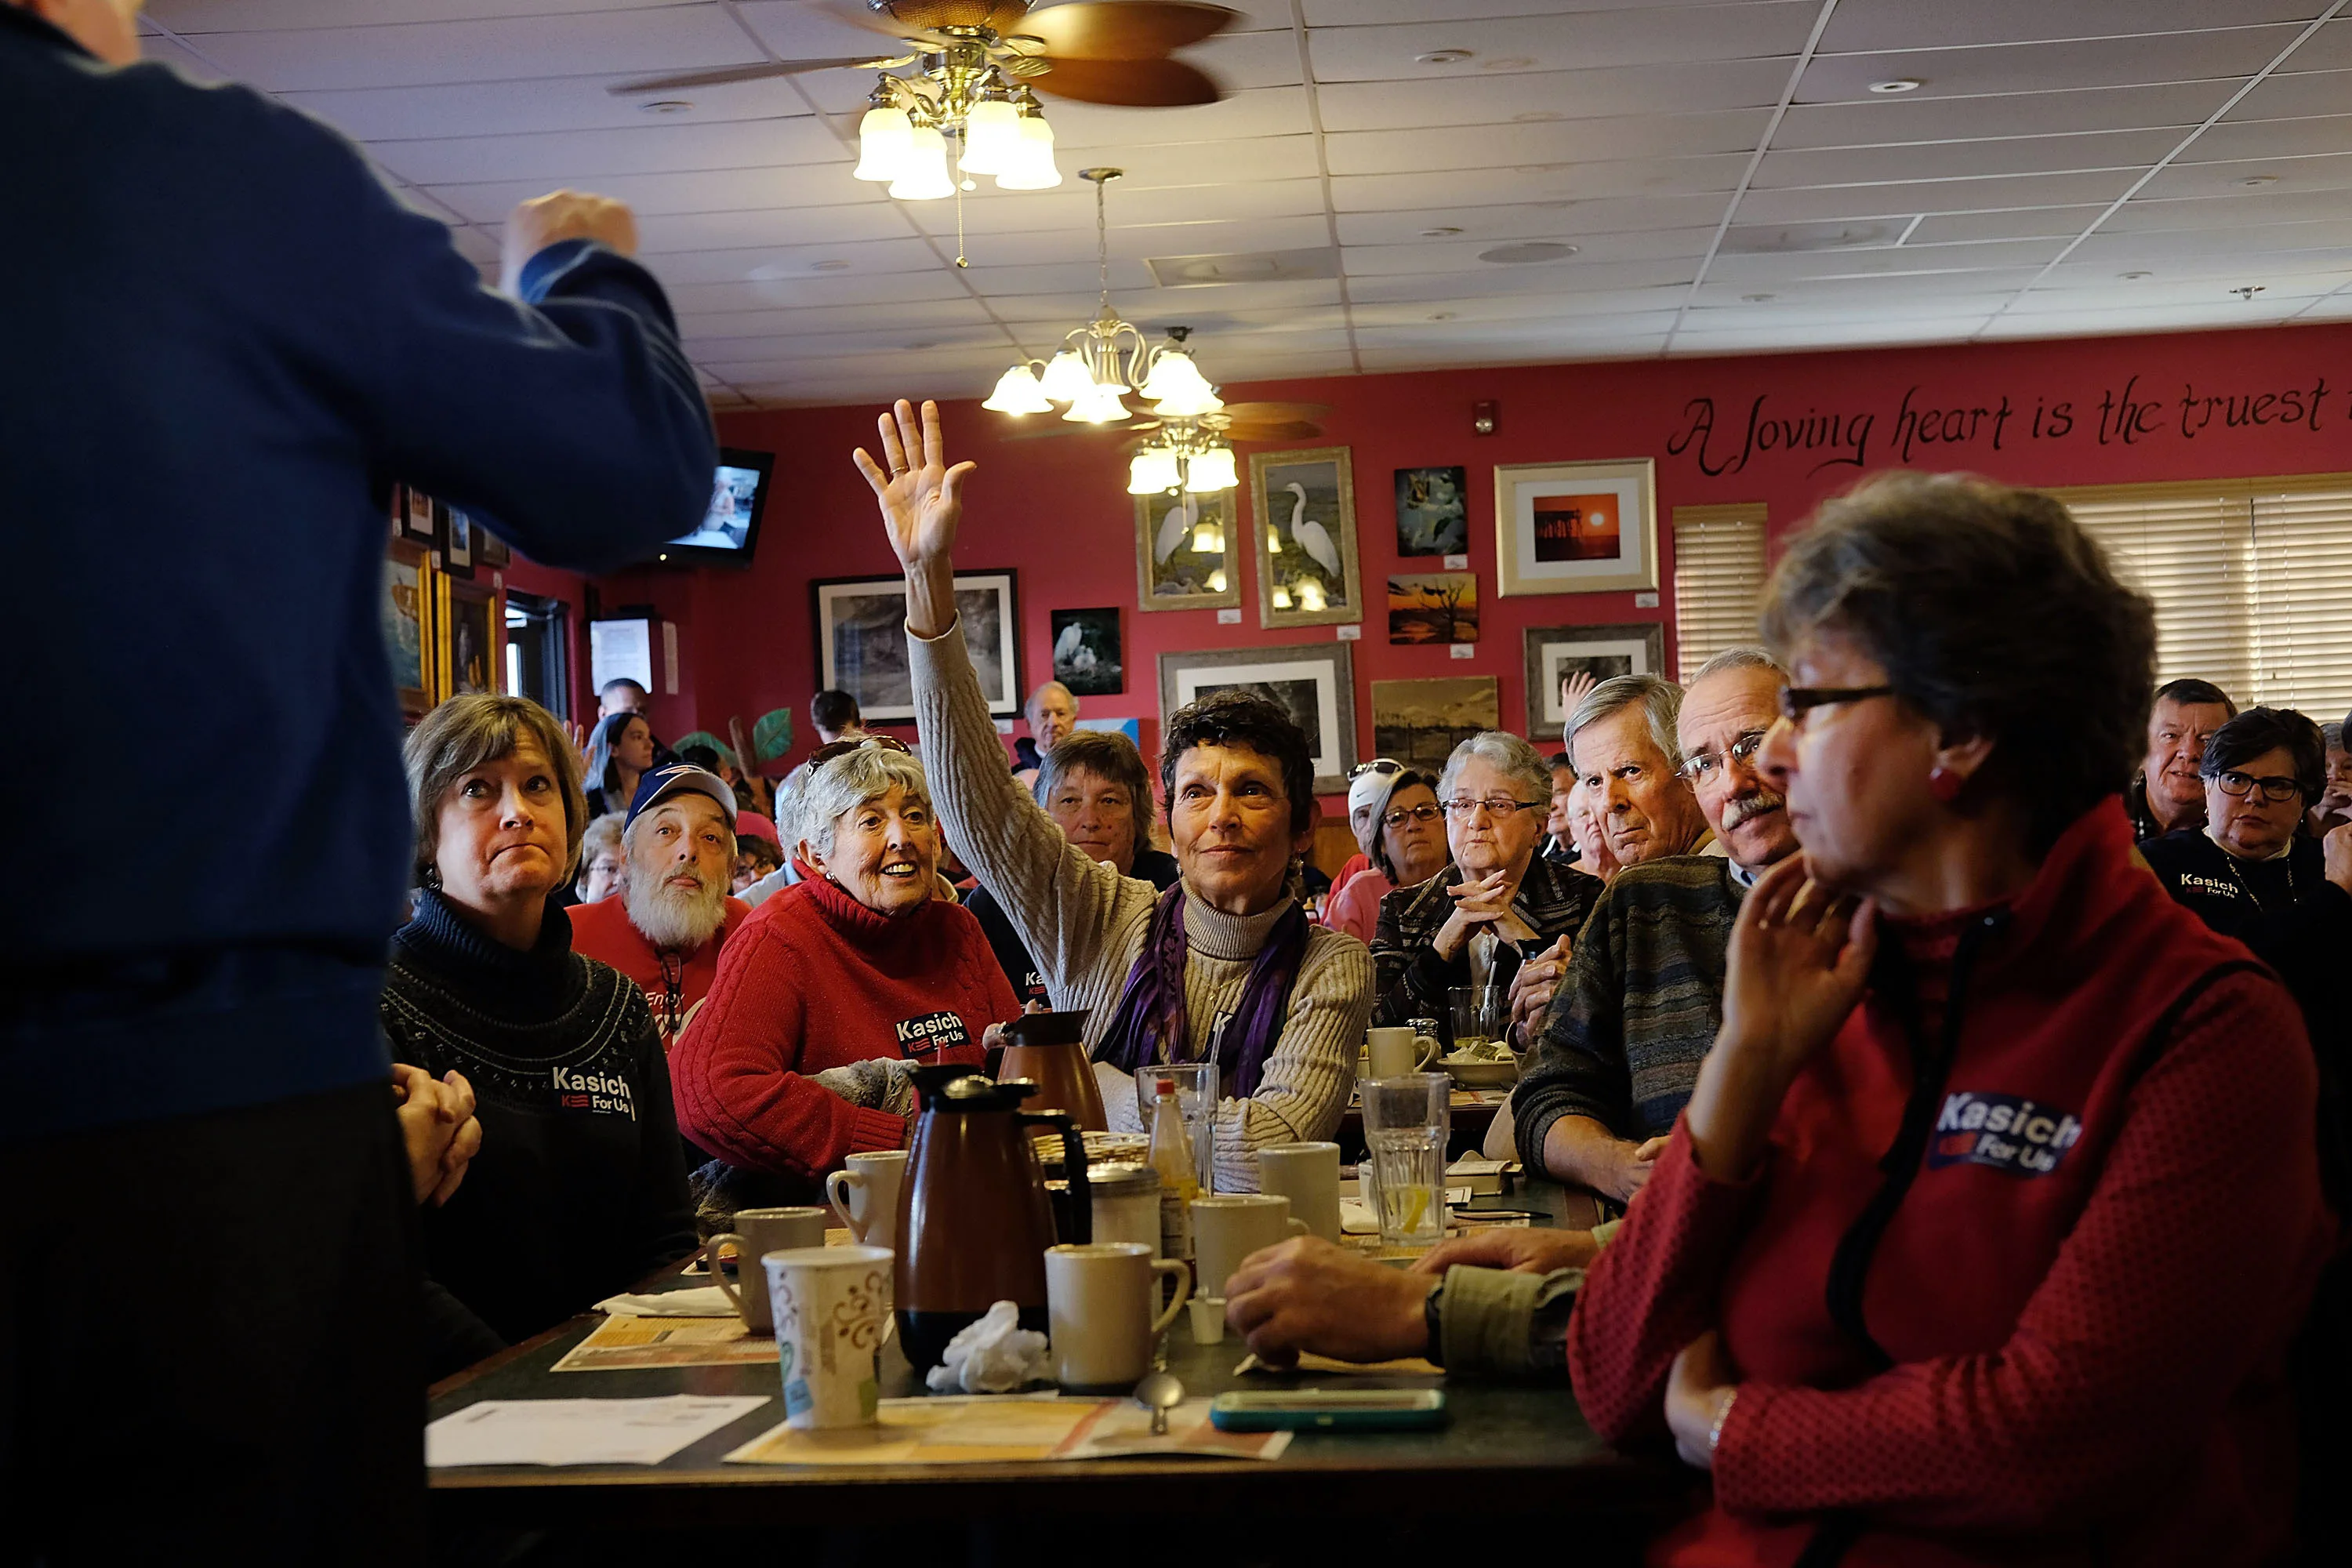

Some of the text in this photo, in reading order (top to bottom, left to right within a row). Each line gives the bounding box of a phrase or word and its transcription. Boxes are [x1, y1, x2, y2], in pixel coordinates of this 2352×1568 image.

[1667, 397, 1737, 477] A
[1731, 394, 1875, 479] loving
[1890, 385, 2013, 463] heart
[2032, 396, 2074, 439] is
[2098, 374, 2167, 446] the
[2179, 376, 2332, 440] truest
[2181, 873, 2238, 894] Kasich
[2223, 890, 2235, 898] Us
[645, 991, 685, 1009] Enoy
[896, 1011, 964, 1042] Kasich
[931, 1034, 949, 1047] For
[949, 1030, 964, 1040] Us
[553, 1066, 631, 1099] Kasich
[592, 1094, 612, 1109] For
[613, 1098, 630, 1113] Us
[1936, 1092, 2083, 1149] Kasich
[1975, 1133, 2019, 1161] For
